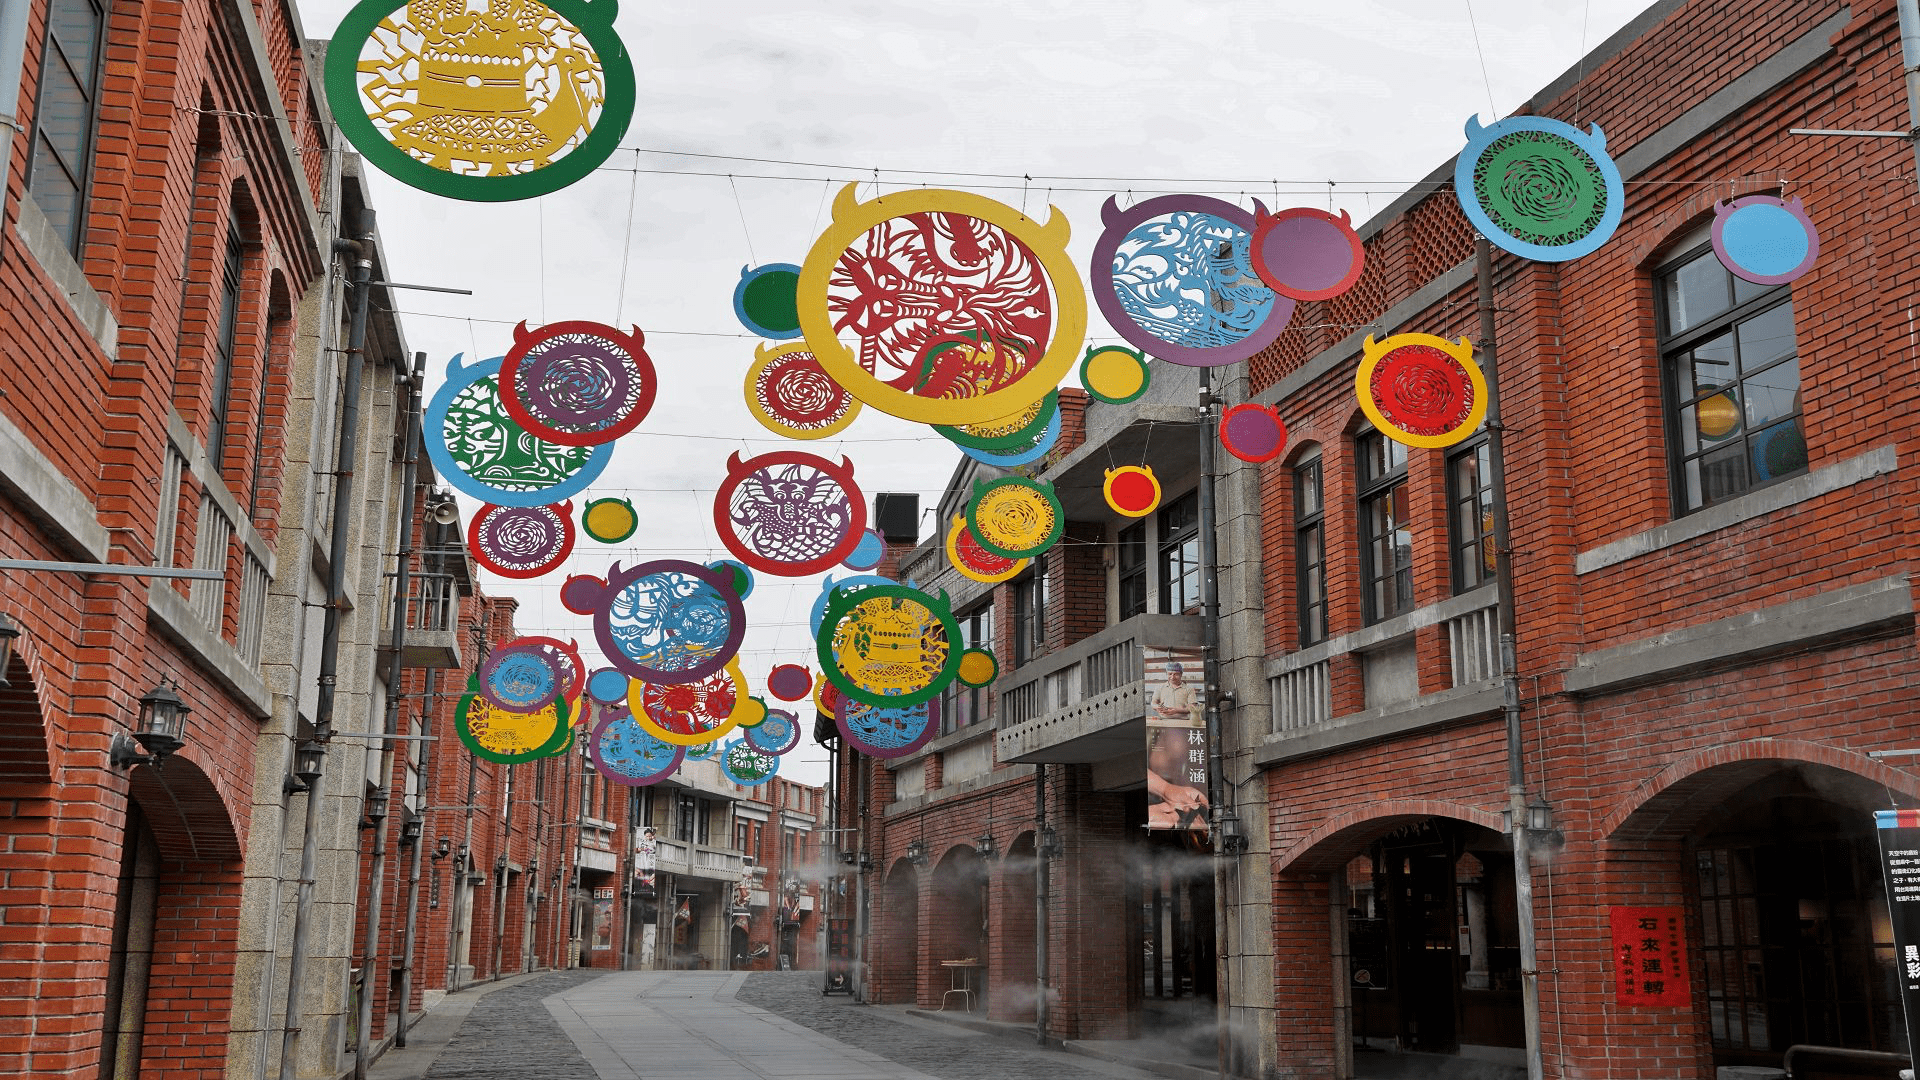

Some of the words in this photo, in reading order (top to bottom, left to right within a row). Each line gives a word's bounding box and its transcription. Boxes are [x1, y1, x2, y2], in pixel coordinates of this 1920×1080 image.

[1188, 730, 1205, 784] 林群涵
[1637, 917, 1665, 994] 石來運轉
